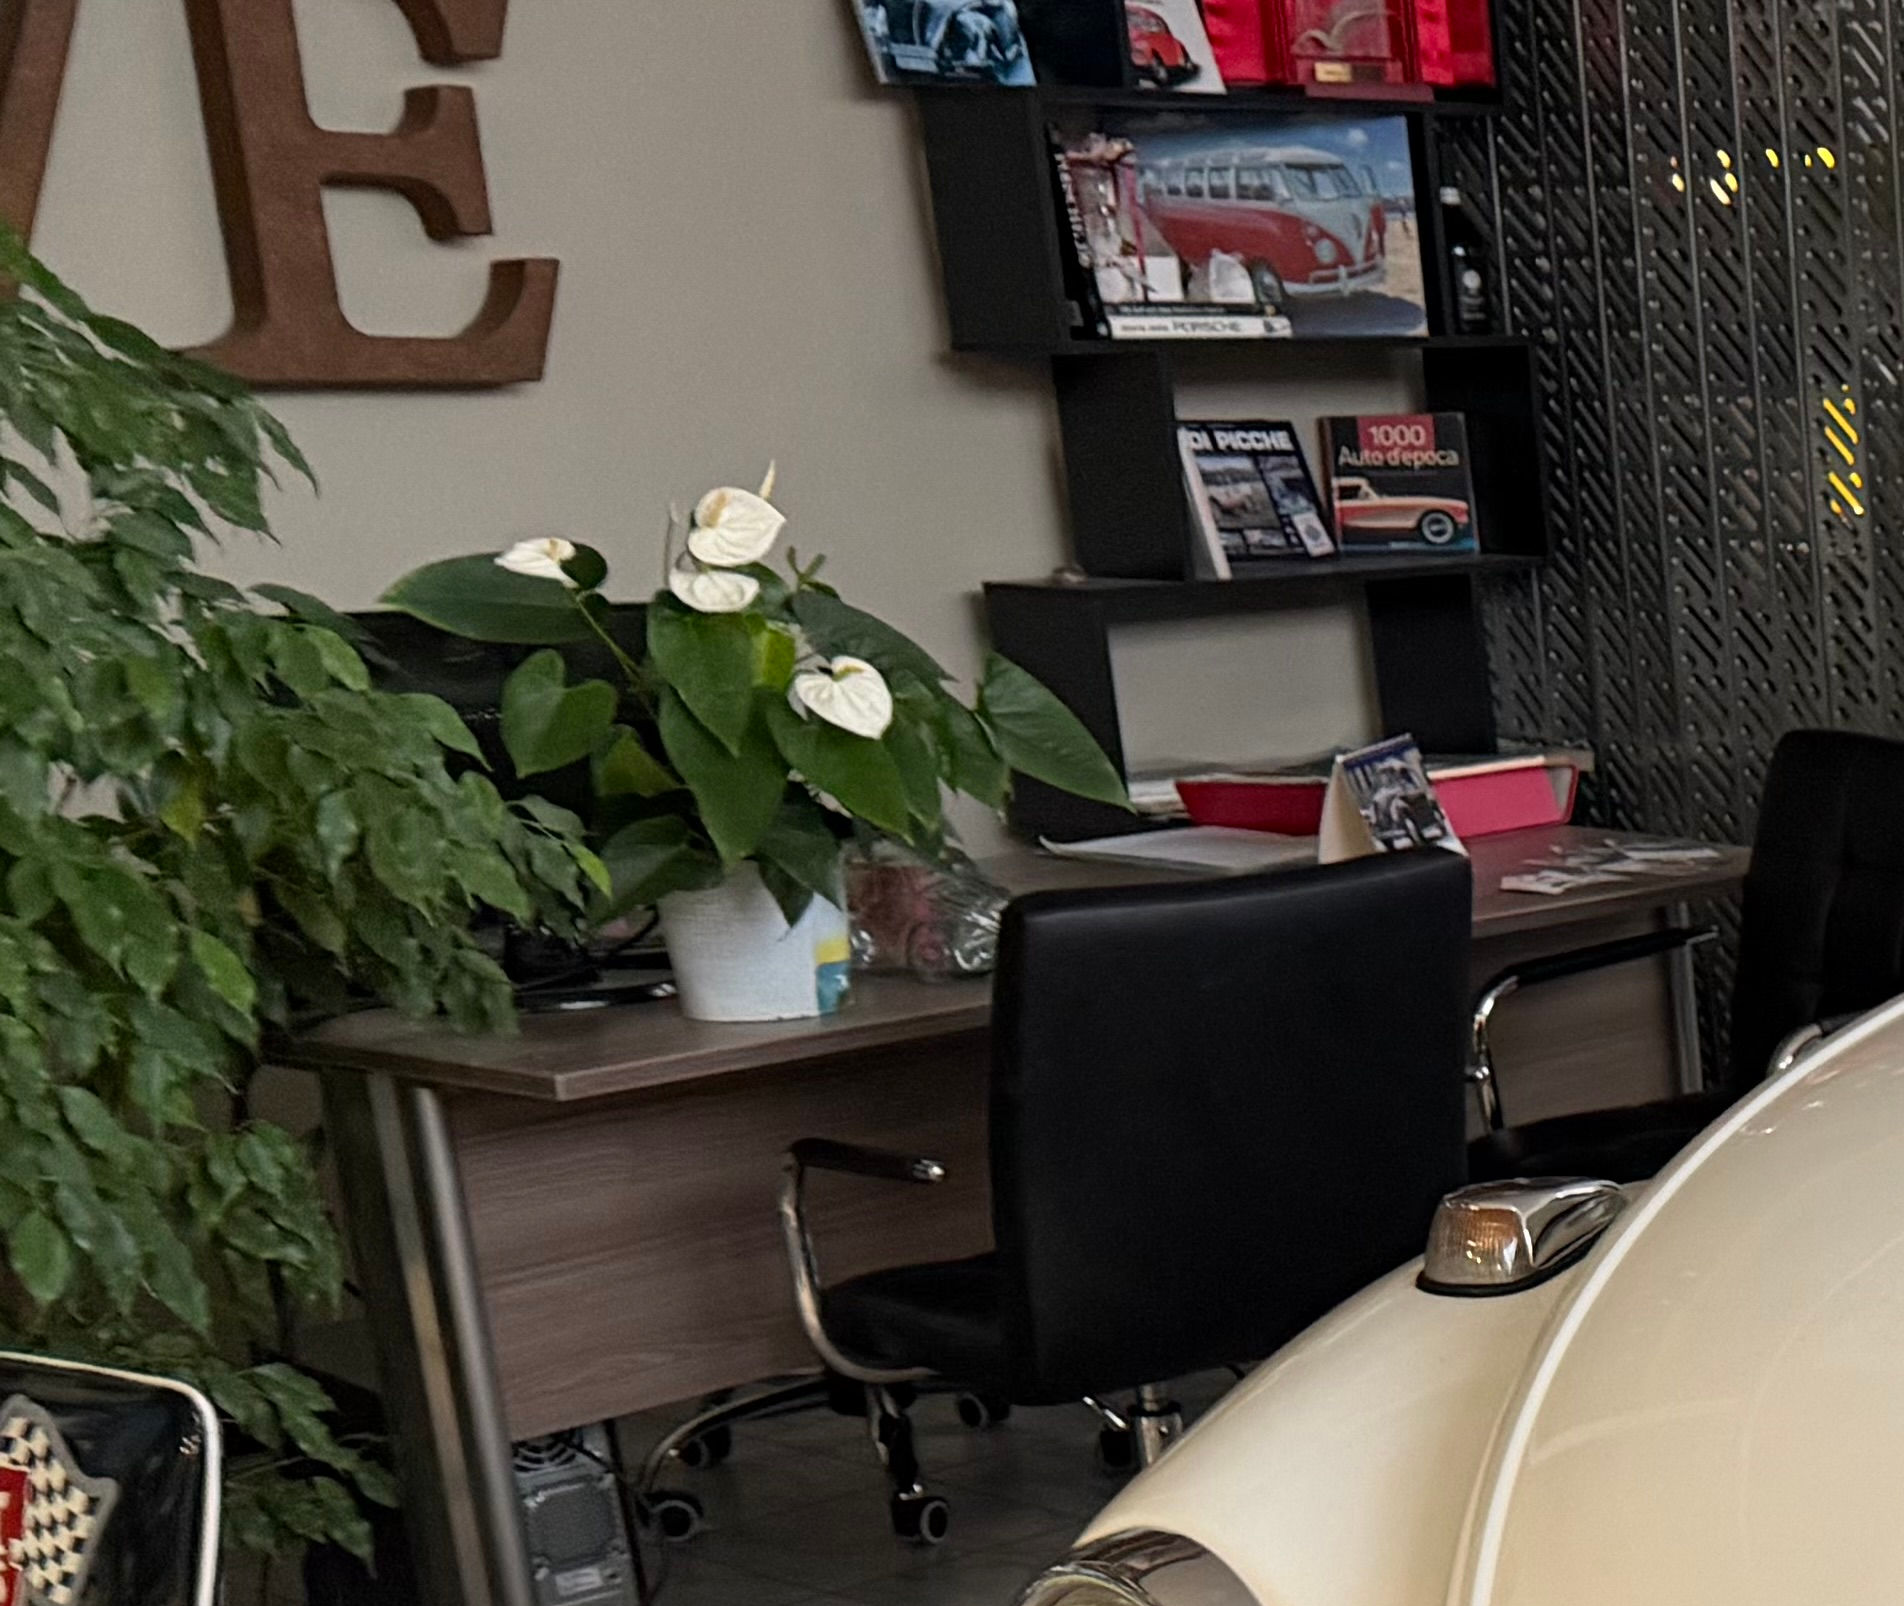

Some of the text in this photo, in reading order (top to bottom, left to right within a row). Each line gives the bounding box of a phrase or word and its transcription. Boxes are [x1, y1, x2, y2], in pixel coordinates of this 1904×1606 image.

[1215, 430, 1294, 451] PICCHE
[1368, 424, 1426, 447] 1000
[1338, 446, 1459, 469] Auto d'epoca
